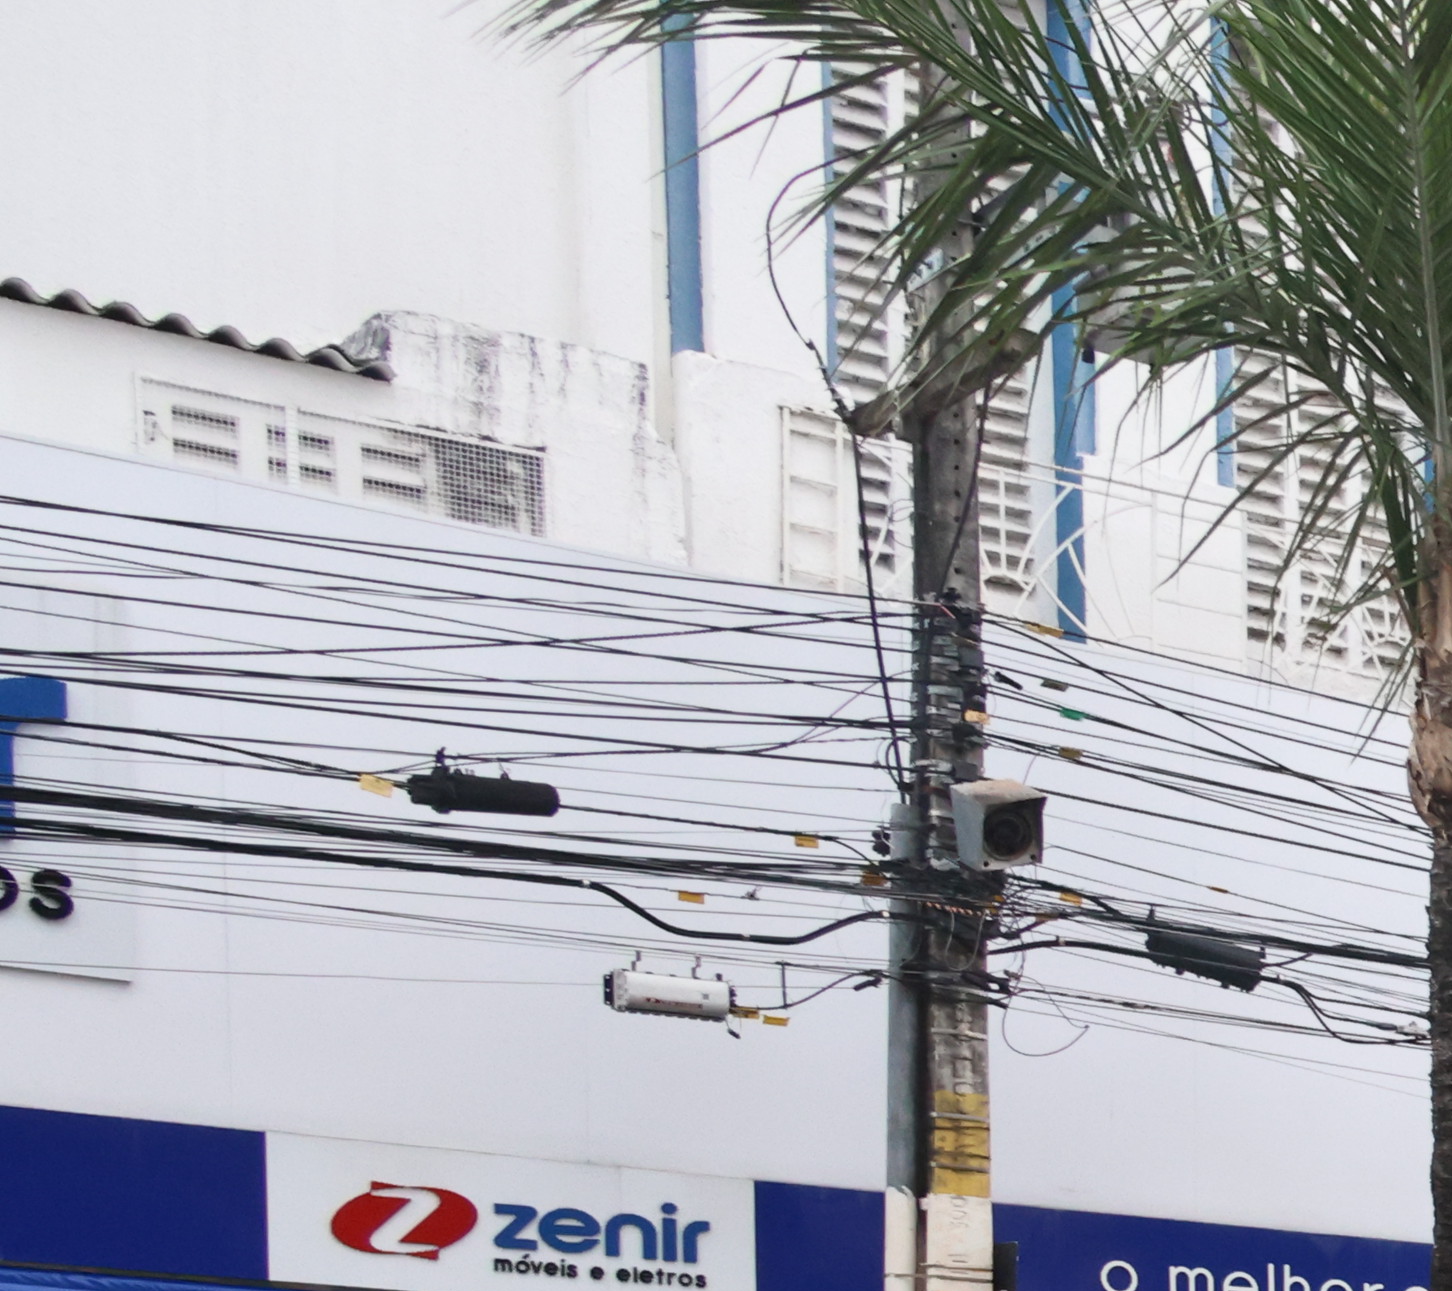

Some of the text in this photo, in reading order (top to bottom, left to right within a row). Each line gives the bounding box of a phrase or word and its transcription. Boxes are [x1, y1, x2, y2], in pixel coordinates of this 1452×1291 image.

[493, 1202, 711, 1264] zenir
[493, 1253, 708, 1289] móveis e eletros
